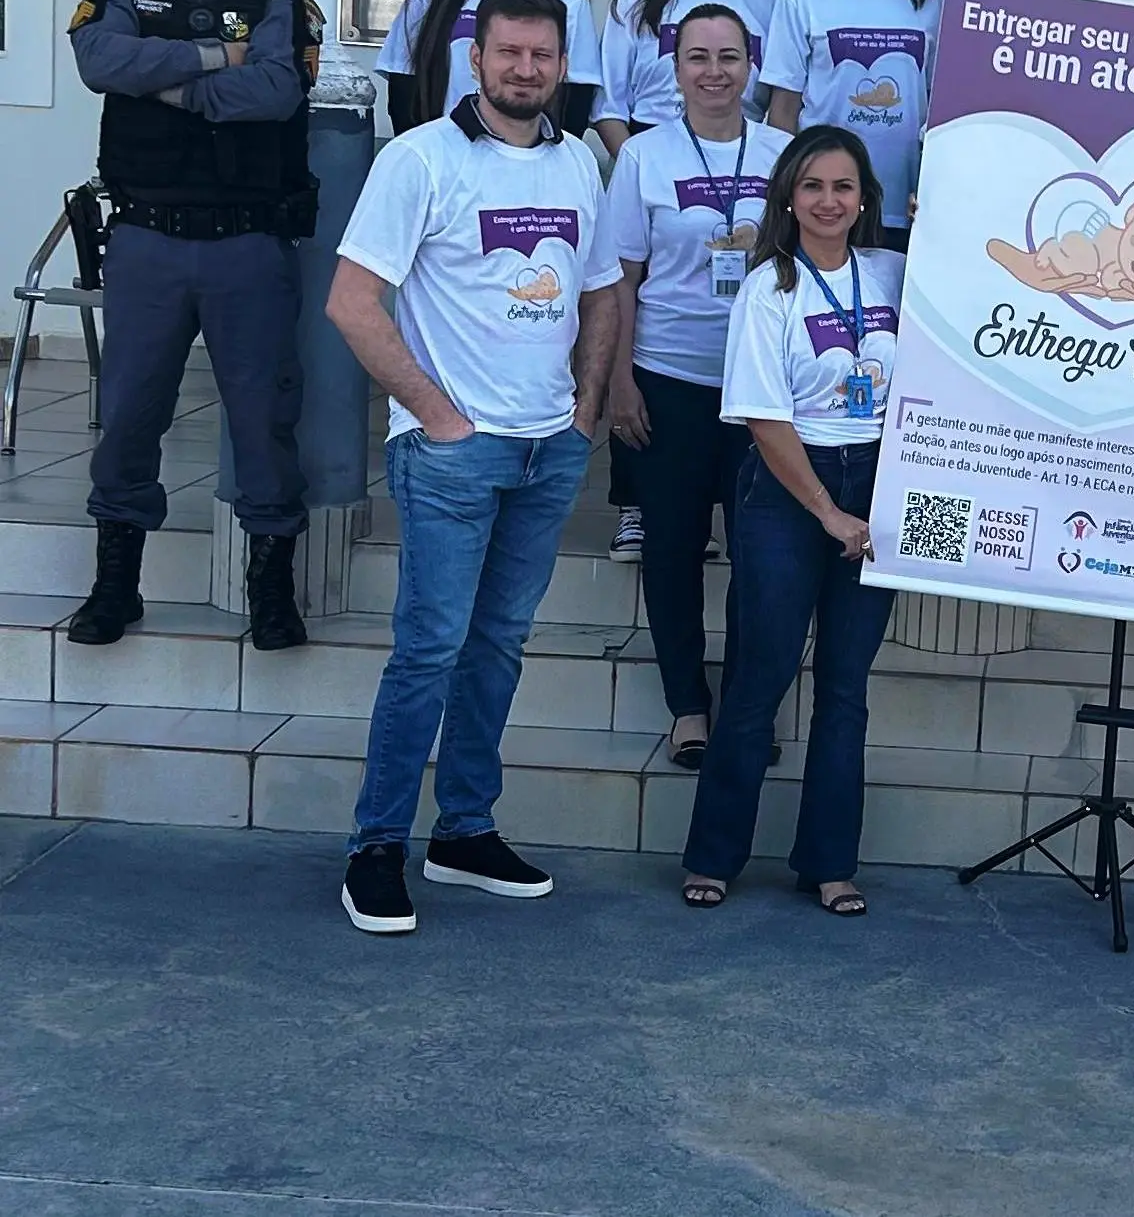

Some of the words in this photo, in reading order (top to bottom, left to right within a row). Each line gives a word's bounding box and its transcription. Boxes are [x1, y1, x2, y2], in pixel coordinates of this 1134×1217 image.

[961, 1, 1076, 46] Entregar
[1080, 28, 1128, 54] seu
[992, 36, 1015, 74] é
[1023, 53, 1081, 86] um
[507, 304, 545, 323] Entrega
[974, 303, 1126, 382] Entrega
[905, 411, 914, 423] A
[917, 414, 966, 431] gestante
[968, 422, 984, 433] ou
[986, 423, 1011, 437] mãe
[1013, 429, 1035, 442] que
[1037, 433, 1094, 450] manifeste
[900, 449, 946, 468] Infância
[947, 458, 955, 469] e
[956, 457, 971, 471] da
[972, 461, 1032, 480] Juventude
[1040, 471, 1060, 485] Art.
[1093, 478, 1117, 493] ECA
[1118, 484, 1126, 494] e
[902, 431, 947, 450] adoção,
[949, 439, 981, 453] antes
[983, 444, 998, 455] ou
[1000, 443, 1025, 461] logo
[1027, 451, 1055, 465] após
[1056, 455, 1064, 465] o
[1066, 456, 1134, 478] nascimento,
[978, 508, 1030, 527] ACESSE
[979, 525, 1025, 543] NOSSO
[974, 541, 1024, 560] PORTAL
